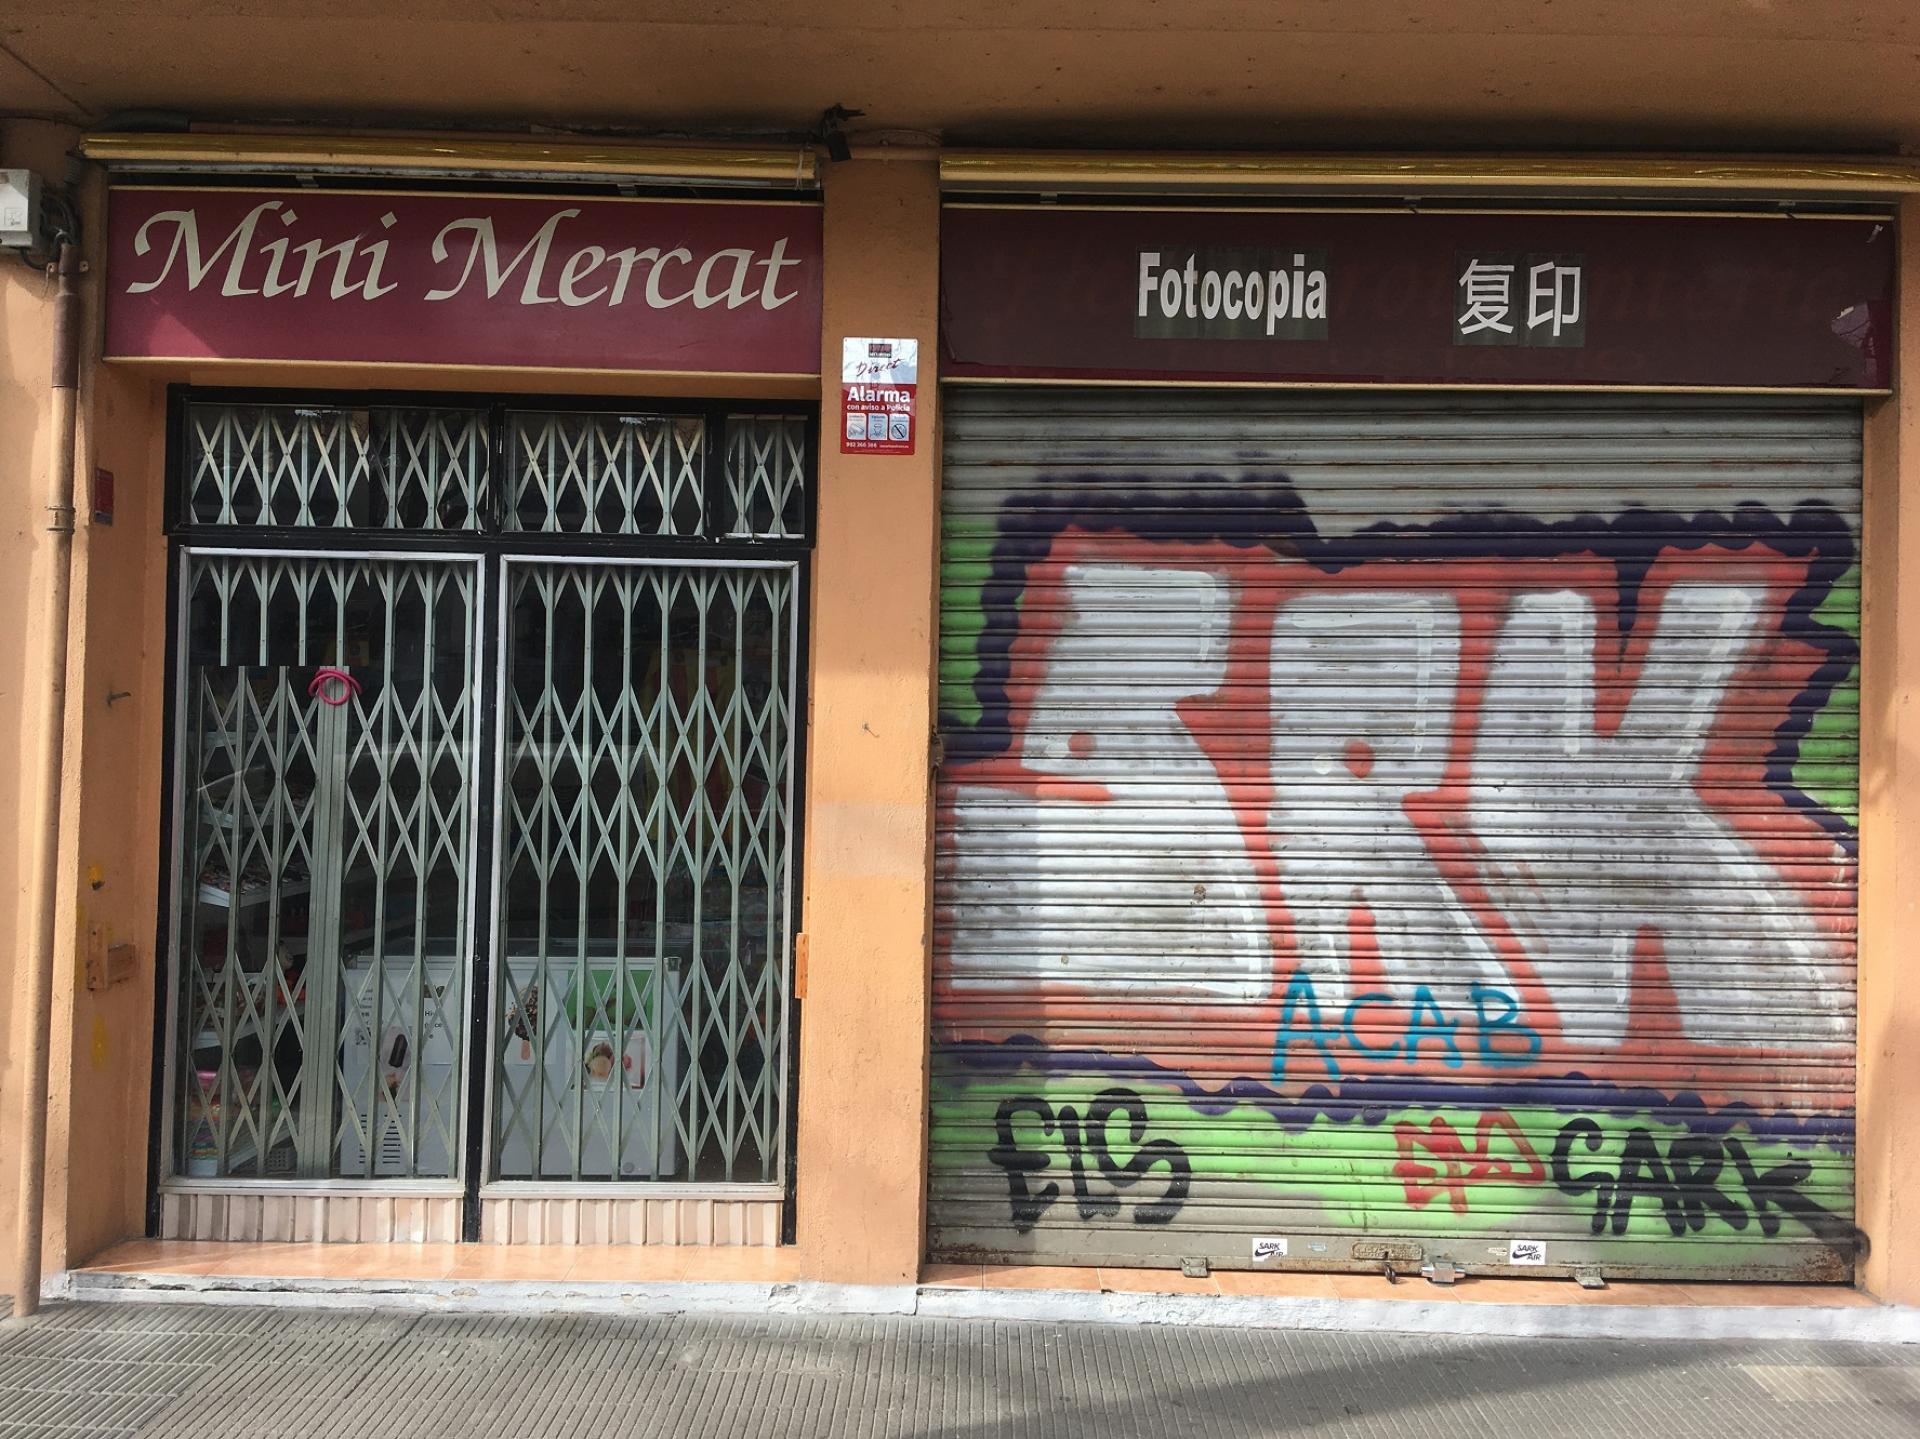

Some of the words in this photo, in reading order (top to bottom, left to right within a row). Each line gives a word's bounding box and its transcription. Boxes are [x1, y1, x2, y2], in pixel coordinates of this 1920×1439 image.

[126, 201, 398, 300] Mini
[424, 209, 802, 310] Mercat
[1138, 252, 1327, 335] Fotocopia
[1457, 258, 1582, 336] 复印
[848, 386, 911, 403] Alarma
[861, 403, 880, 411] aviso
[1271, 971, 1543, 1085] ACAB
[1259, 1242, 1281, 1250] SARK
